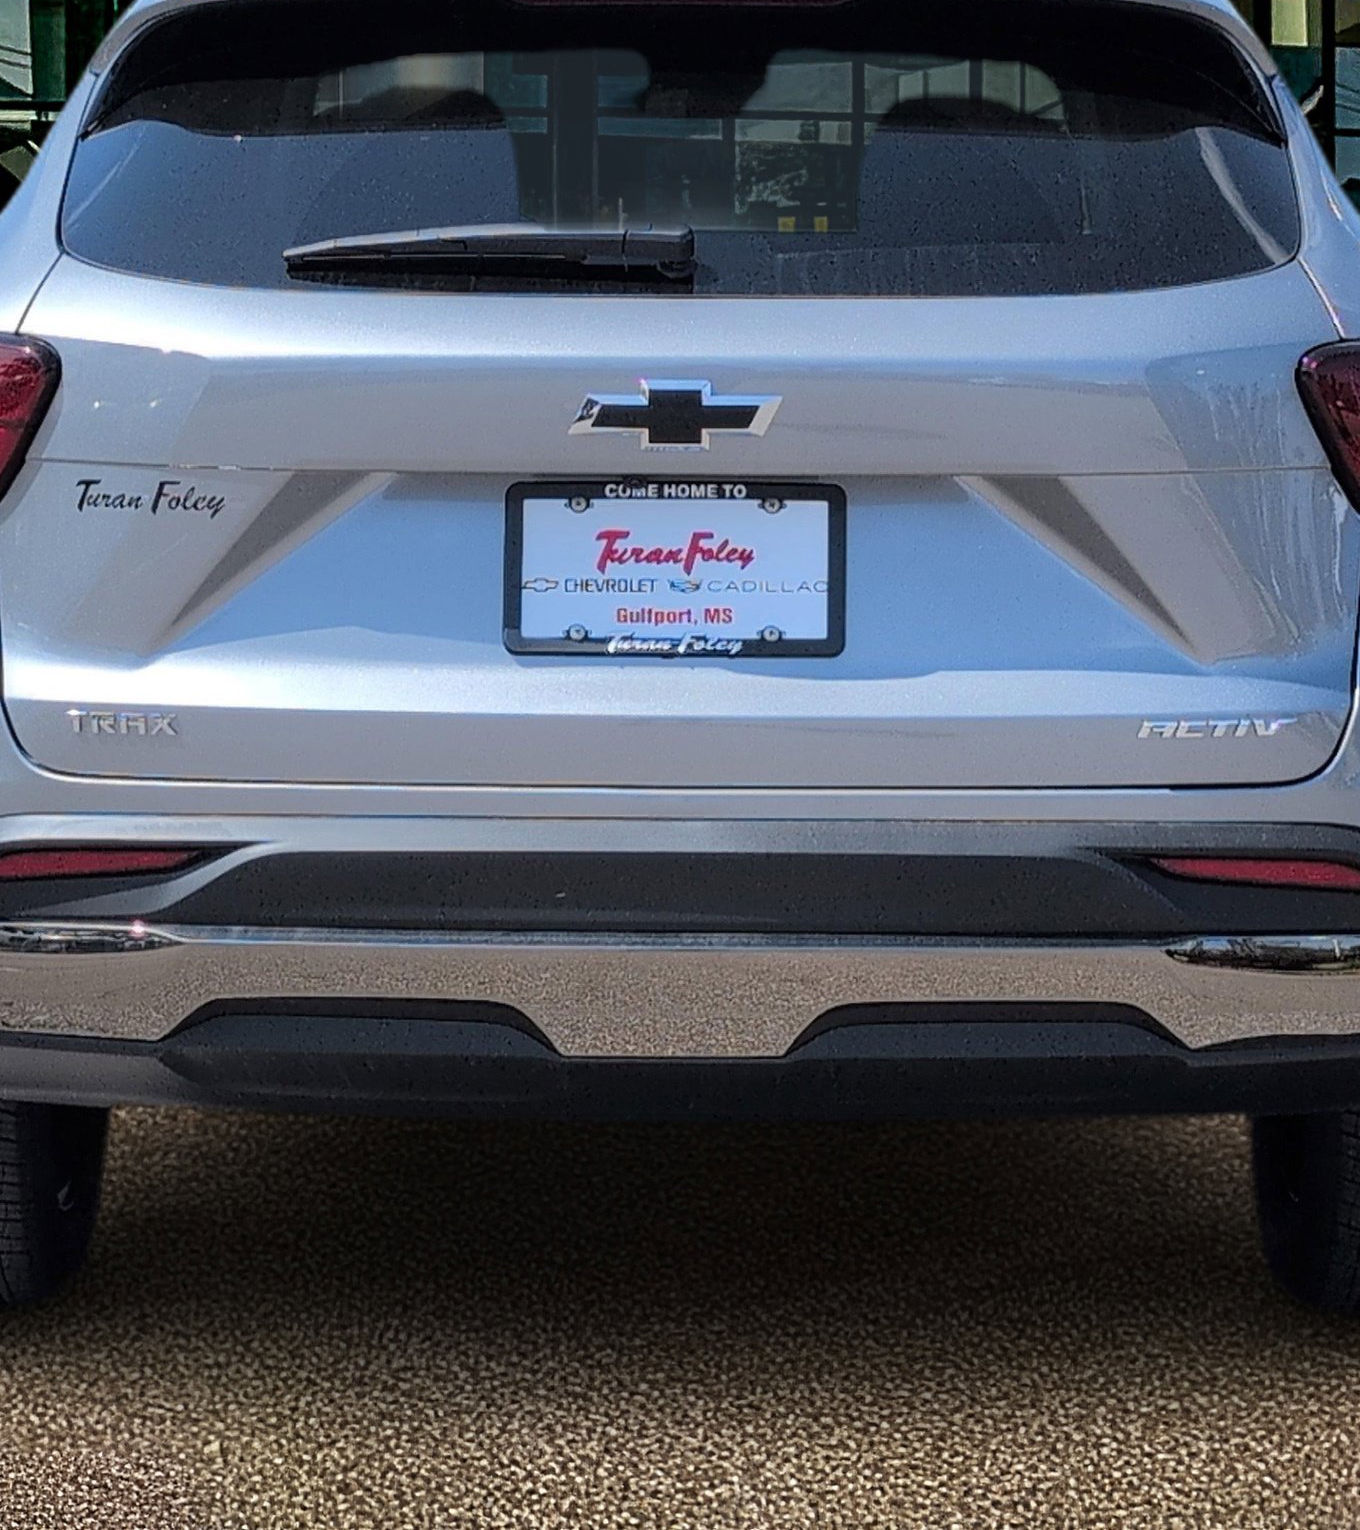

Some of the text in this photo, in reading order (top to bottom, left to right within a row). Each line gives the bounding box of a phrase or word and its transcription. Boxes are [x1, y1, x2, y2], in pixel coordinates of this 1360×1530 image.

[76, 479, 225, 519] Turan Foley
[604, 483, 747, 499] COME HOME TO
[595, 530, 755, 576] Turan Foley
[565, 579, 829, 593] CHEVROLET CADILLAC
[616, 607, 733, 626] Gulfport, MS
[65, 708, 178, 736] TRAX
[1138, 718, 1297, 738] ACTIV
